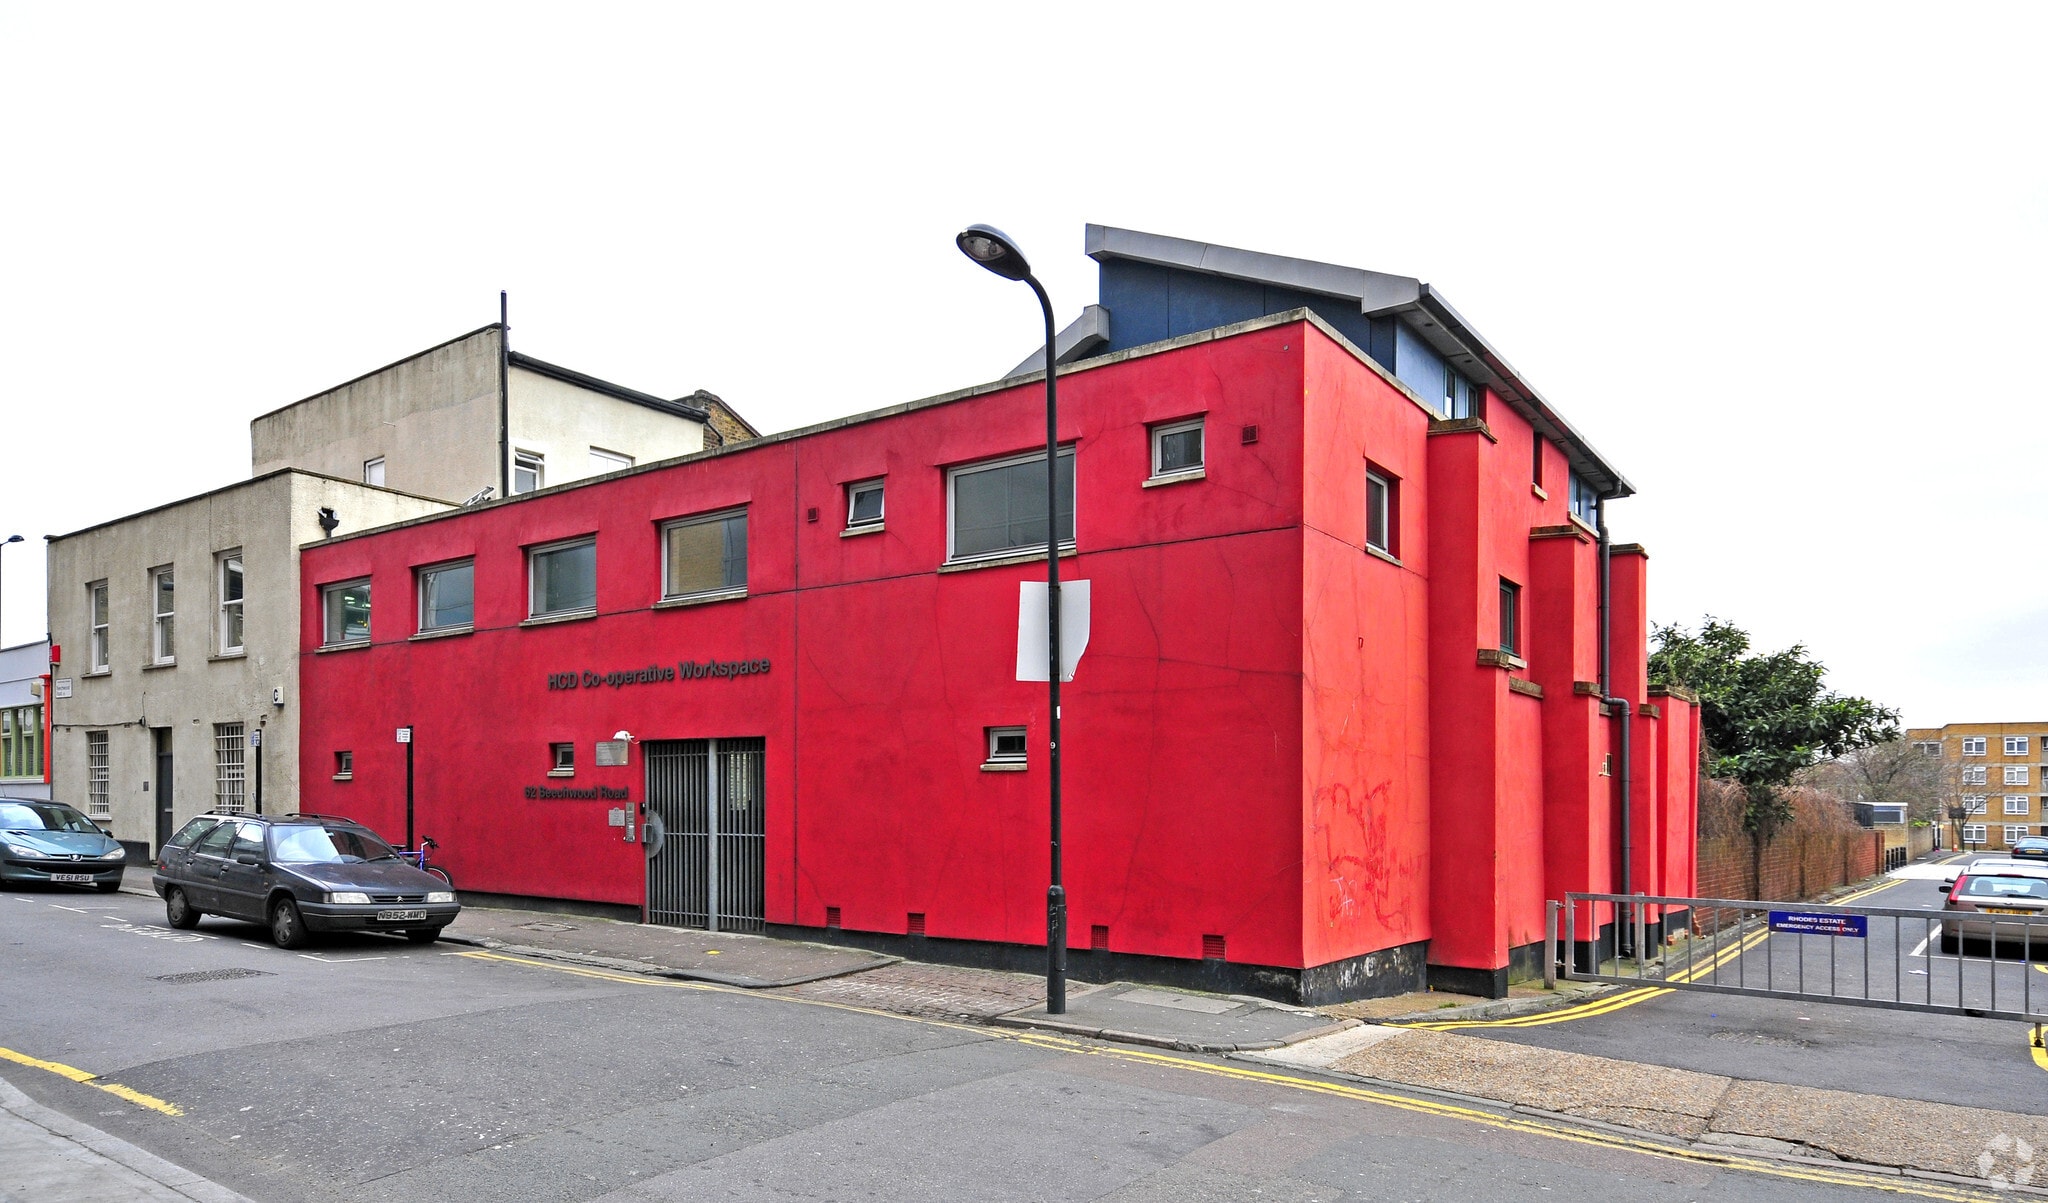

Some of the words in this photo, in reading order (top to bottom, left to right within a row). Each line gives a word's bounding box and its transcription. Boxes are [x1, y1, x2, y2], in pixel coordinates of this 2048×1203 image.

[548, 671, 578, 691] HCD
[582, 663, 675, 689] Co-operative
[678, 657, 770, 681] Workspace
[525, 785, 537, 799] 62
[538, 785, 597, 799] Beechwood
[599, 785, 629, 799] Road
[1776, 922, 1814, 930] EMERGENCY
[1787, 915, 1818, 923] RHODES
[1819, 917, 1847, 925] ESTATE
